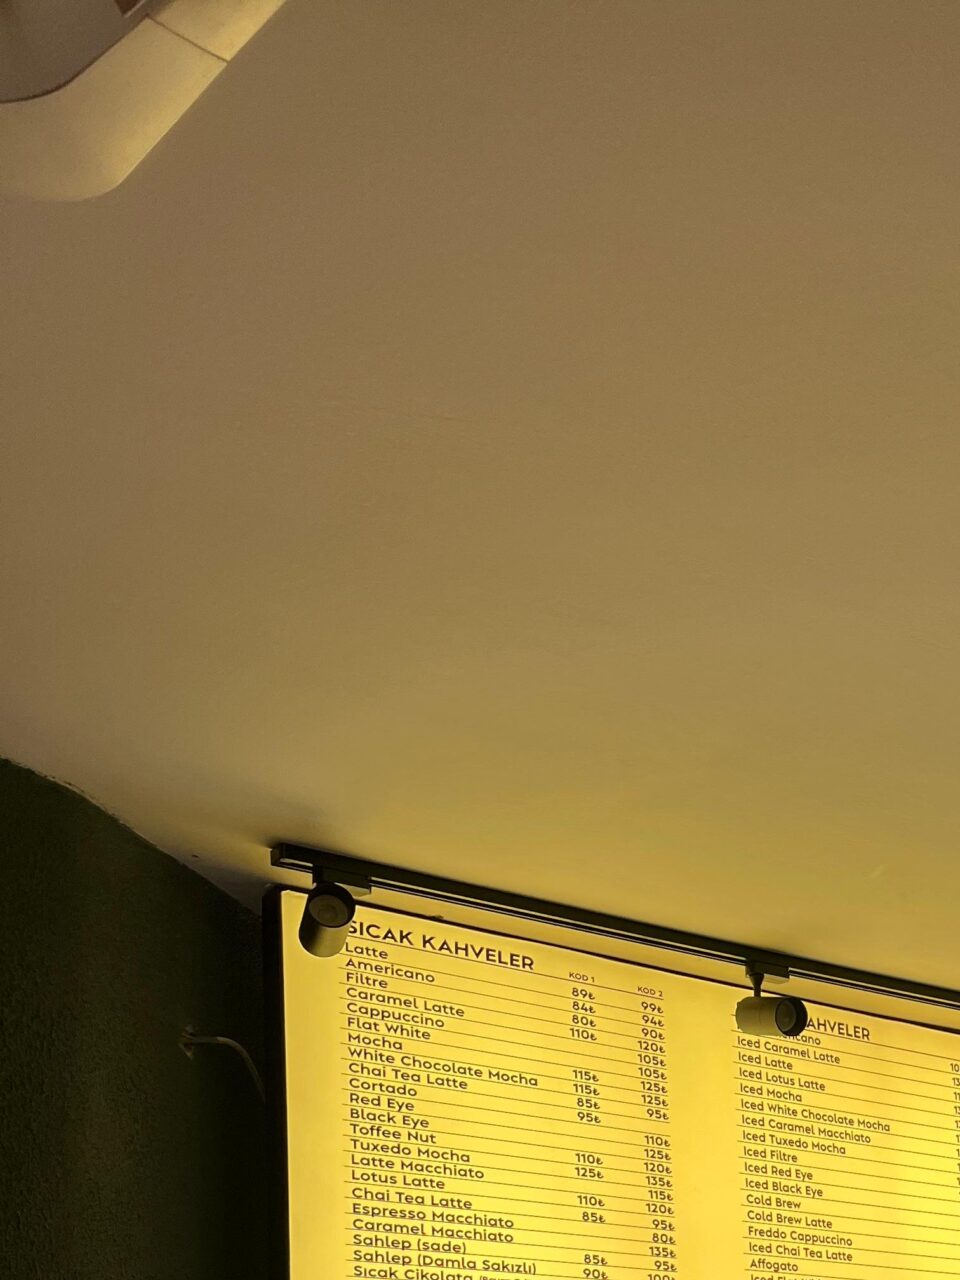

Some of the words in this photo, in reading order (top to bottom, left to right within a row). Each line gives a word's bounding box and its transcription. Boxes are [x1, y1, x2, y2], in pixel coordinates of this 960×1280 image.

[345, 941, 388, 959] Latte
[347, 920, 414, 946] SICAK
[421, 937, 534, 970] KAHVELER
[344, 957, 435, 982] Americano
[346, 971, 388, 988] Filtre
[568, 971, 588, 981] KOD
[346, 986, 418, 1009] Caramel
[423, 1000, 464, 1017] Latte
[637, 985, 656, 995] KOD
[346, 1001, 444, 1031] Cappuccino
[347, 1016, 380, 1032] Flat
[383, 1022, 431, 1040] White
[806, 1018, 870, 1040] AHVELER
[737, 1035, 760, 1049] Iced
[763, 1040, 810, 1058] Caramel
[813, 1050, 840, 1064] Latte
[347, 1046, 395, 1063] White
[400, 1055, 483, 1077] Chocolate
[487, 1068, 537, 1086] Mocha
[348, 1077, 417, 1096] Cortado
[349, 1107, 396, 1124] Black
[402, 1114, 429, 1131] Eye
[349, 1137, 411, 1155] Tuxedo
[416, 1146, 470, 1162] Mocha
[743, 1145, 766, 1158] Iced
[769, 1149, 797, 1163] Filtre
[351, 1153, 395, 1169] Latte
[400, 1159, 484, 1179] Macchiato
[746, 1193, 772, 1206] Cold
[775, 1196, 801, 1208] Brew
[352, 1202, 426, 1221] Espresso
[431, 1210, 514, 1227] Macchiato
[747, 1225, 786, 1239] Freddo
[789, 1230, 853, 1249] Cappuccino
[352, 1249, 412, 1266] Sahlep
[417, 1253, 476, 1270] (Damla
[481, 1259, 536, 1275] Sakızlı)
[749, 1257, 799, 1275] Affogato
